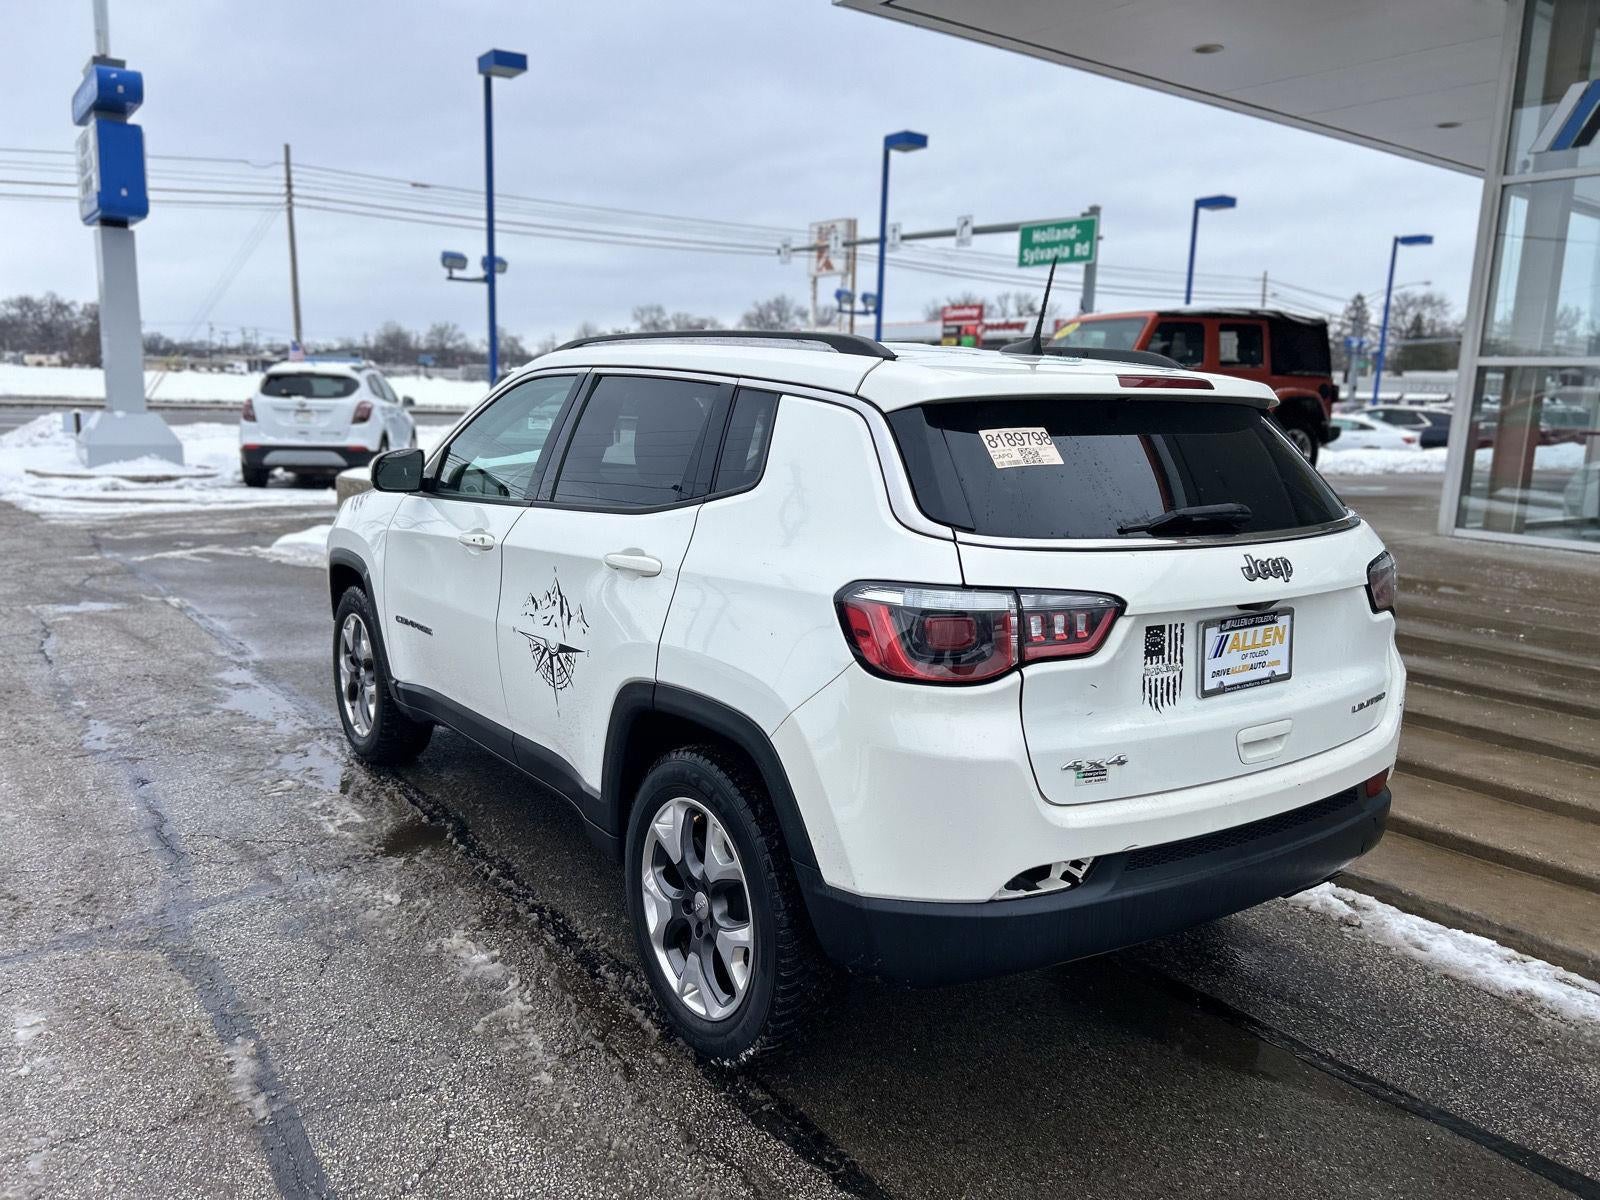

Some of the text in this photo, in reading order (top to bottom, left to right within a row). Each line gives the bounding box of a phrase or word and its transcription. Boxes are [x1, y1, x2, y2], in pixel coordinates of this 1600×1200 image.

[1032, 224, 1081, 243] Holland-
[1022, 241, 1090, 265] Sylvania Rd
[986, 432, 1053, 449] 8189798
[1241, 554, 1293, 582] Jeep
[1231, 619, 1247, 628] ALLEN
[1255, 615, 1274, 623] TOLEDO
[1227, 625, 1286, 653] ALLEN
[1250, 650, 1268, 658] TOLEDO
